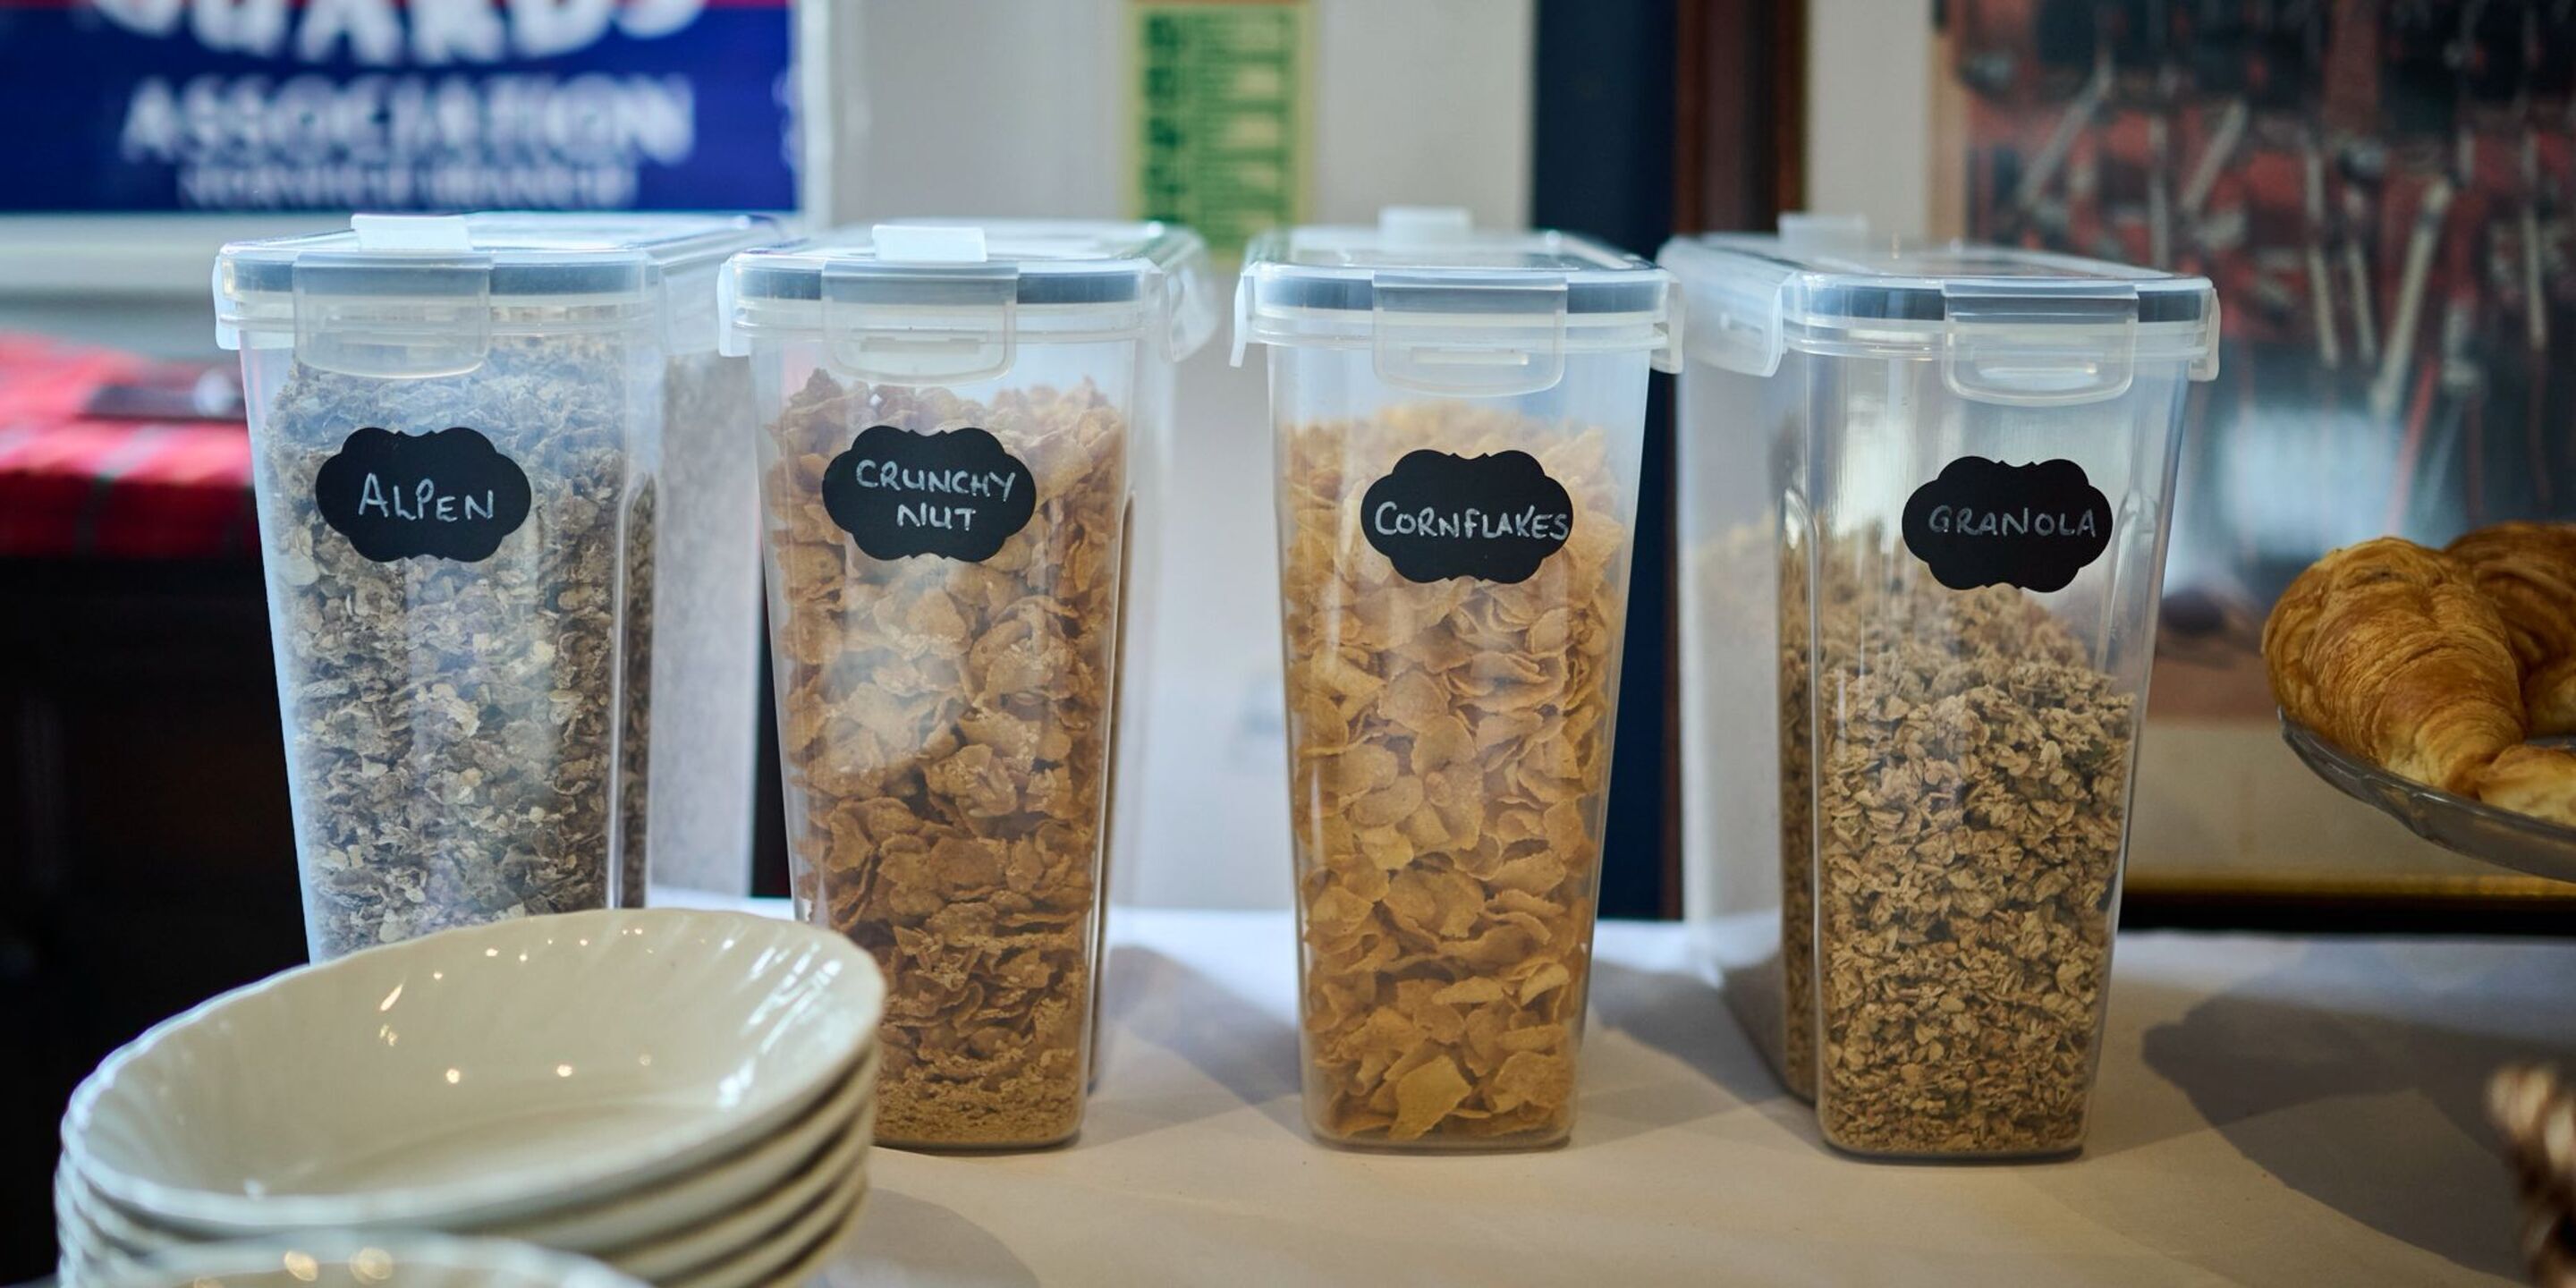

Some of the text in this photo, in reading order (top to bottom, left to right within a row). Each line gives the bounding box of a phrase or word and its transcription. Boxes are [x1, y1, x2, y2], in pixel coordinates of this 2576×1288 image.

[121, 73, 694, 163] ASSOCIATION
[856, 459, 1016, 503] CRUNCHY
[896, 502, 977, 531] NUT
[1375, 501, 1569, 540] CORNFLAKES
[1928, 504, 2097, 538] GRANOLA
